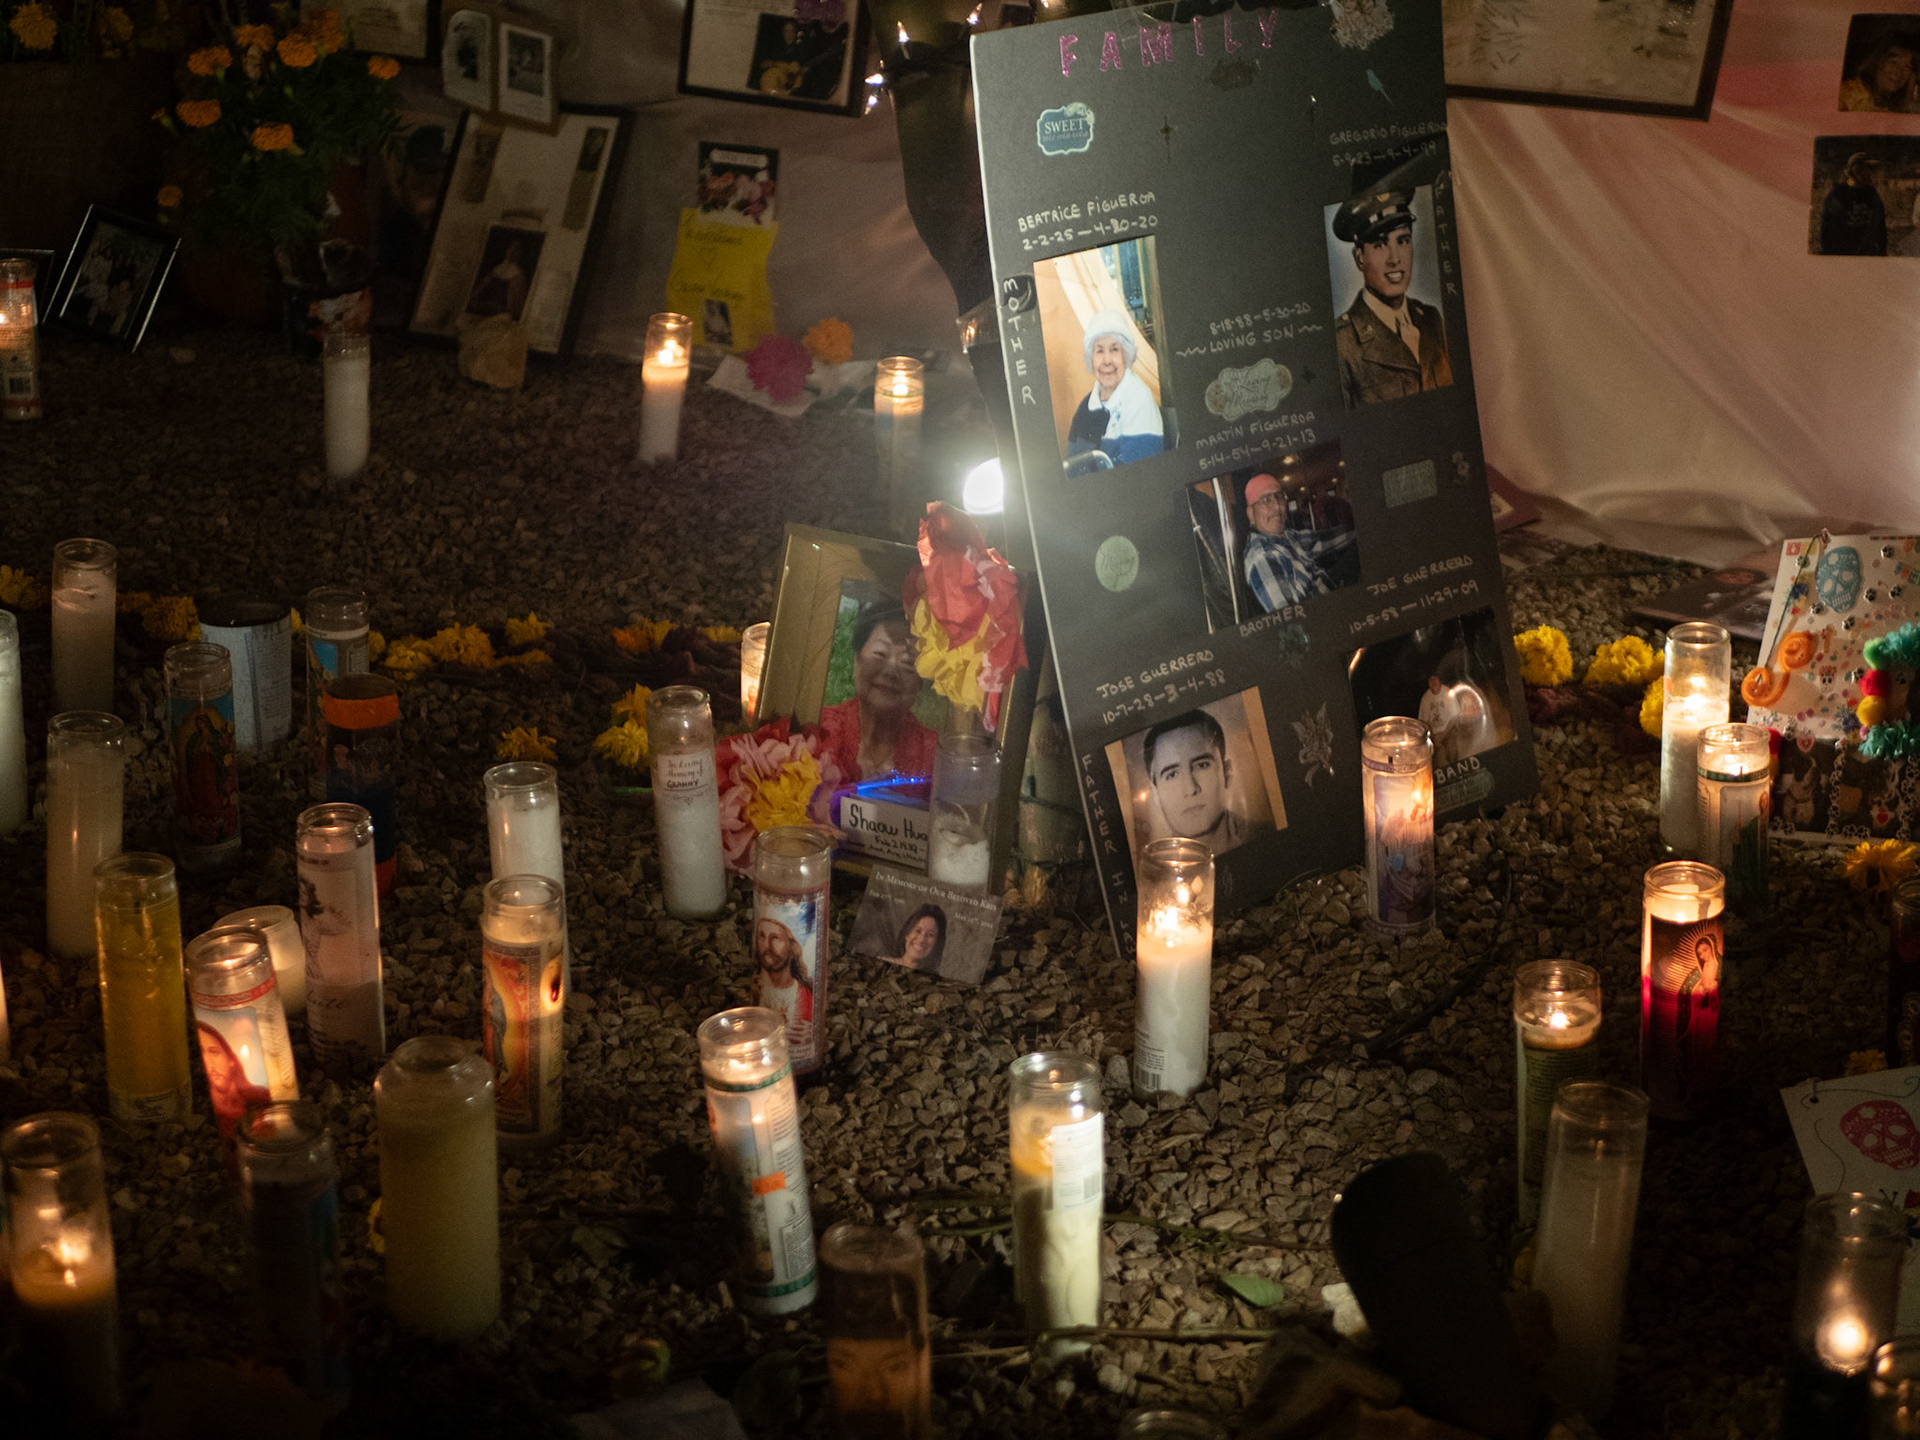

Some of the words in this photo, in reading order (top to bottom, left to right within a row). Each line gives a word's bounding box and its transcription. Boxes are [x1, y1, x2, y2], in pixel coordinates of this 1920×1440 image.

[1059, 6, 1279, 77] FAMILY
[1044, 117, 1087, 134] SWEET
[1003, 277, 1037, 405] MOTHER
[1209, 332, 1257, 353] LOVING
[1262, 323, 1295, 343] SON
[1366, 576, 1398, 596] JOE
[1402, 555, 1475, 585] GUERRERO
[1239, 604, 1308, 638] BROTHER
[1095, 675, 1136, 698] JOSE
[1139, 649, 1215, 683] GUERRERO
